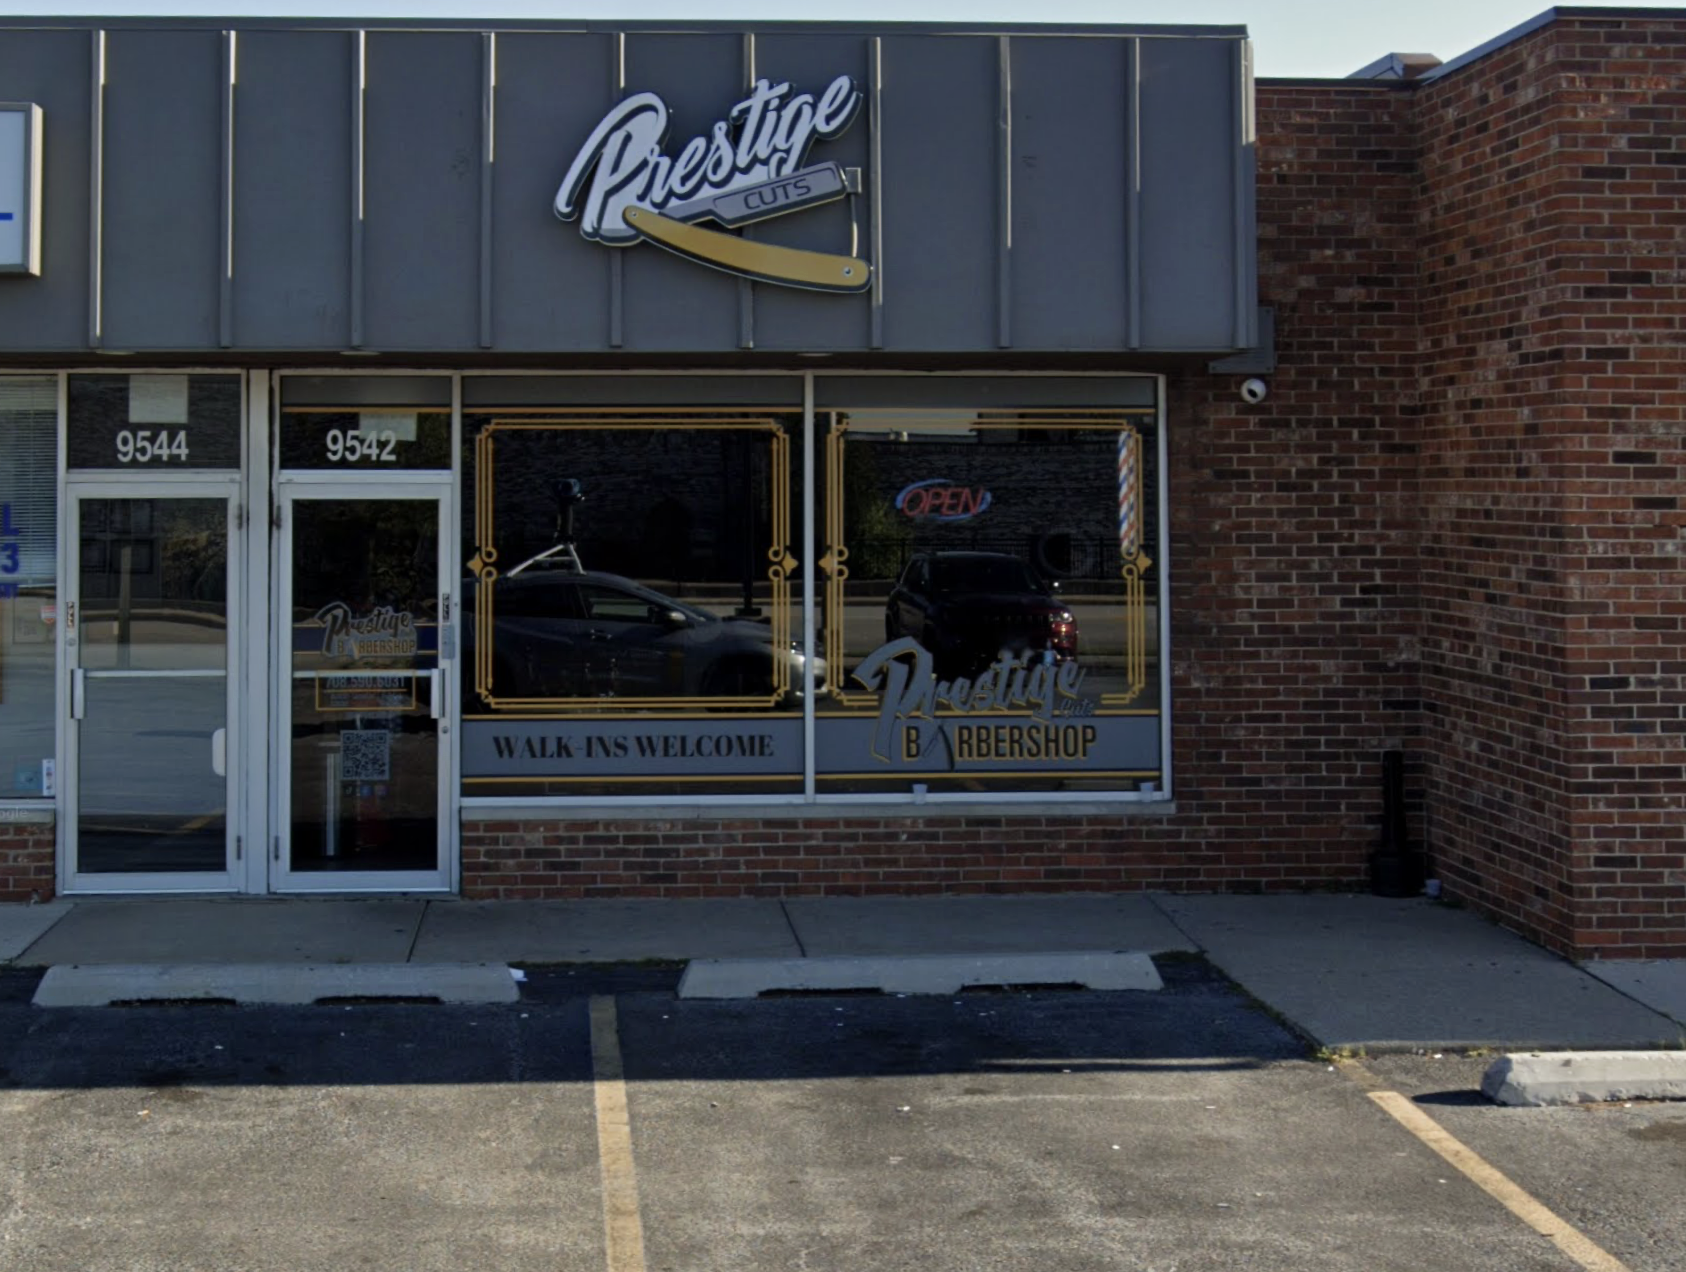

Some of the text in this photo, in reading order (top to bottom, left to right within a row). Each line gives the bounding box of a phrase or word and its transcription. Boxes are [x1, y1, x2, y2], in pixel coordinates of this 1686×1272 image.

[555, 75, 861, 234] Prestige
[743, 178, 812, 210] CUTS
[116, 430, 189, 462] 9544
[326, 429, 397, 462] 9542
[901, 486, 988, 517] OPEN
[315, 602, 409, 656] Prestige
[851, 636, 1087, 764] Prestige
[492, 734, 774, 759] WALK-INS WELCOME
[902, 724, 1097, 766] BARBERSHOP
